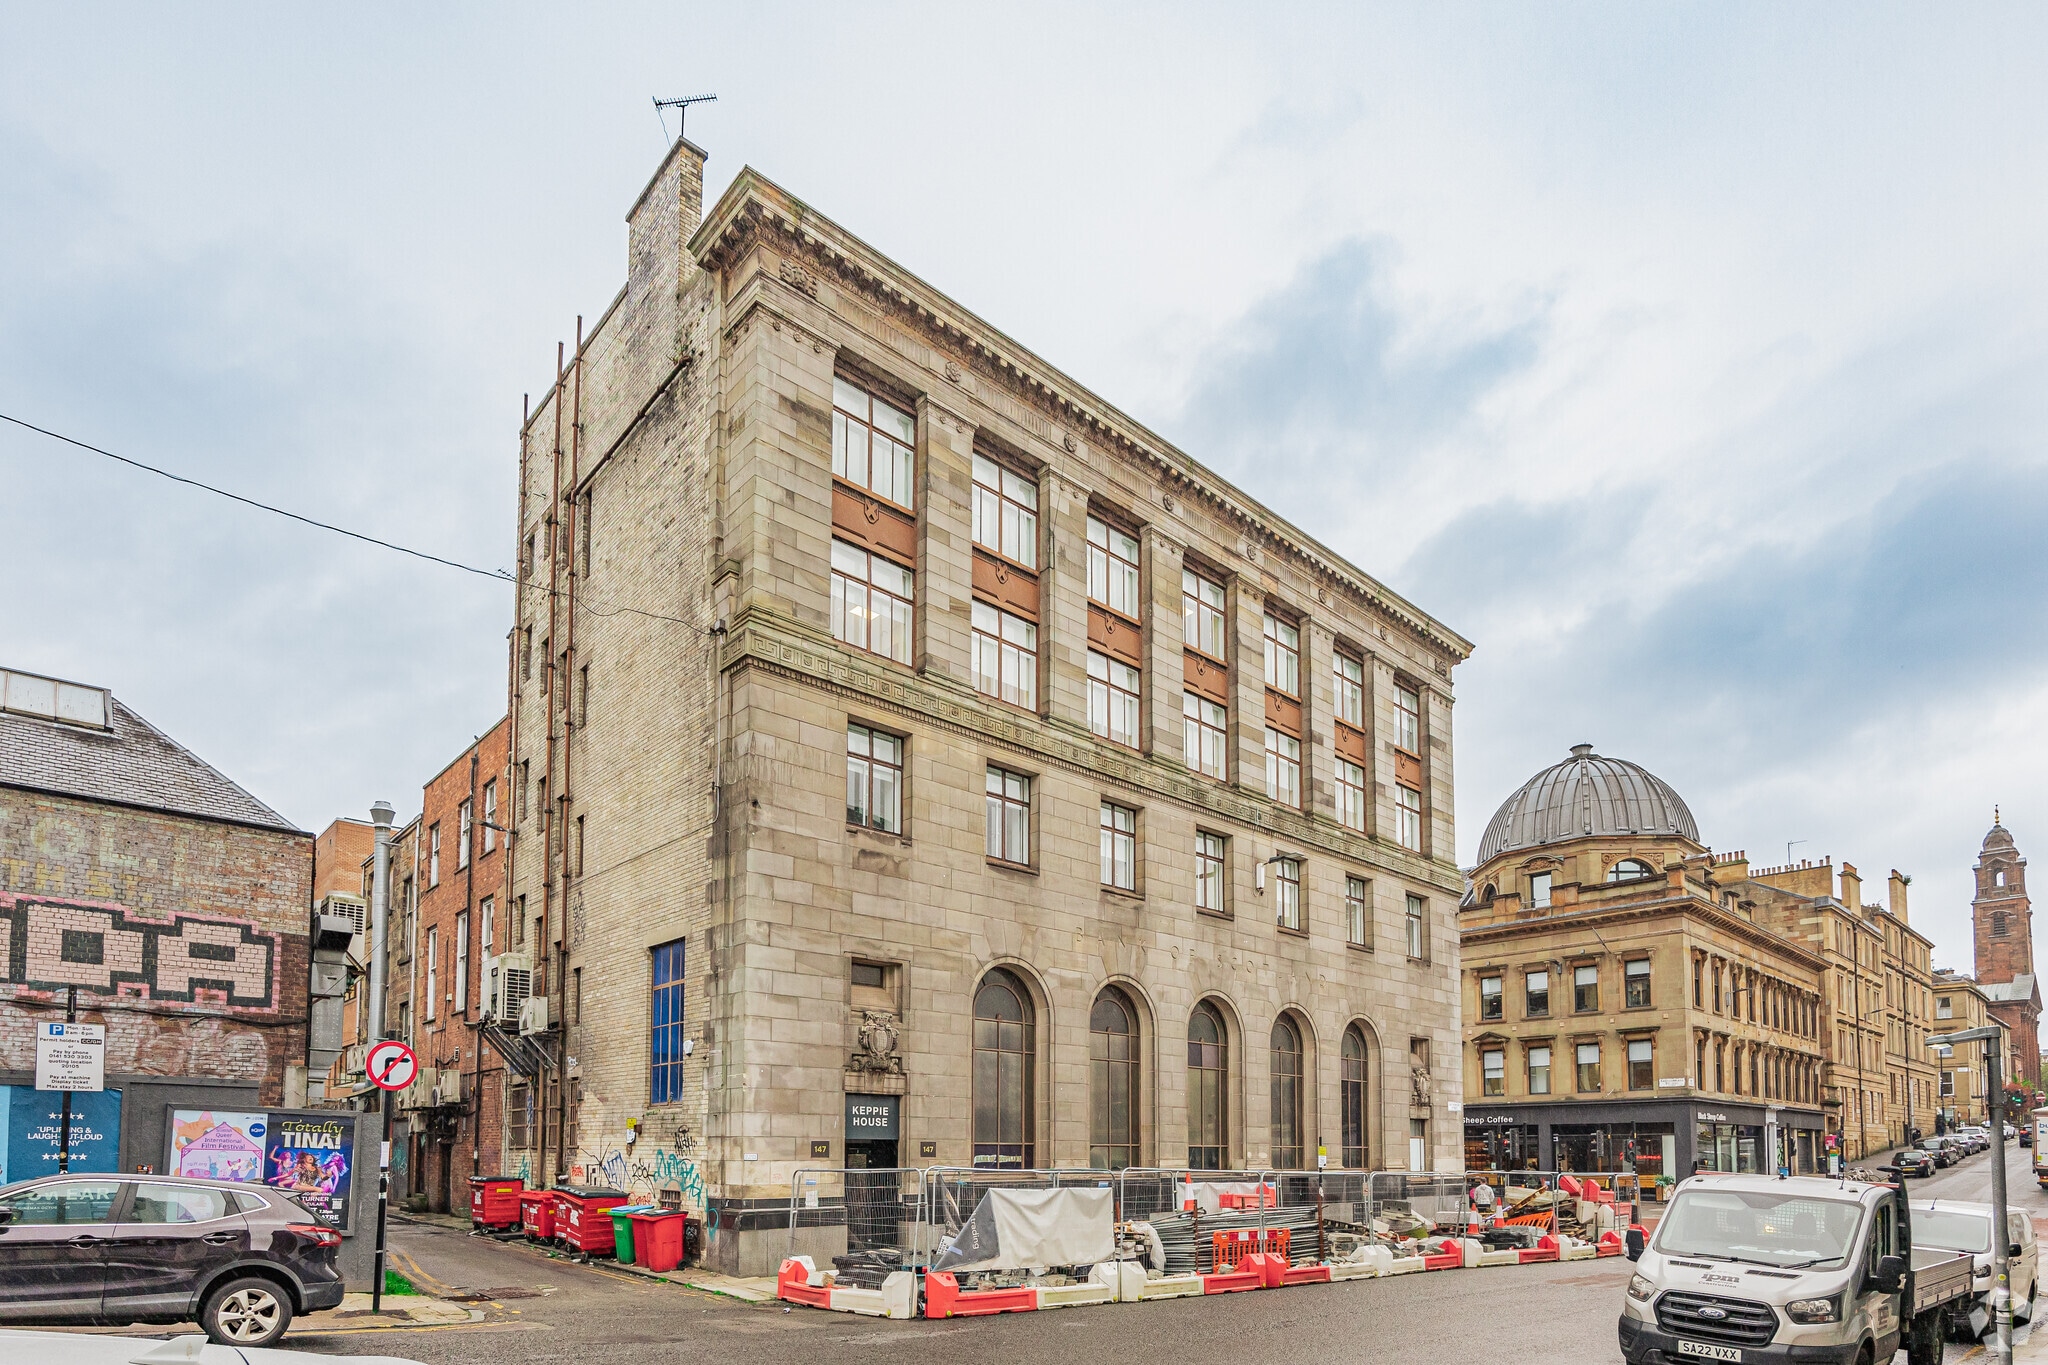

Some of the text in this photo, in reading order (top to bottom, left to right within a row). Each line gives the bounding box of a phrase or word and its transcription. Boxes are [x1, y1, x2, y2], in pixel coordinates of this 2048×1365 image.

[53, 1025, 62, 1035] P
[852, 1106, 889, 1116] KEPPIE
[853, 1117, 888, 1127] HOUSE
[1487, 1115, 1514, 1123] Coffee
[282, 1119, 344, 1138] Totally
[281, 1131, 341, 1150] TINA!
[814, 1145, 827, 1153] 147
[970, 1217, 980, 1250] trading
[1698, 1281, 1737, 1289] Construction
[1683, 1342, 1737, 1360] SA22 VXX
